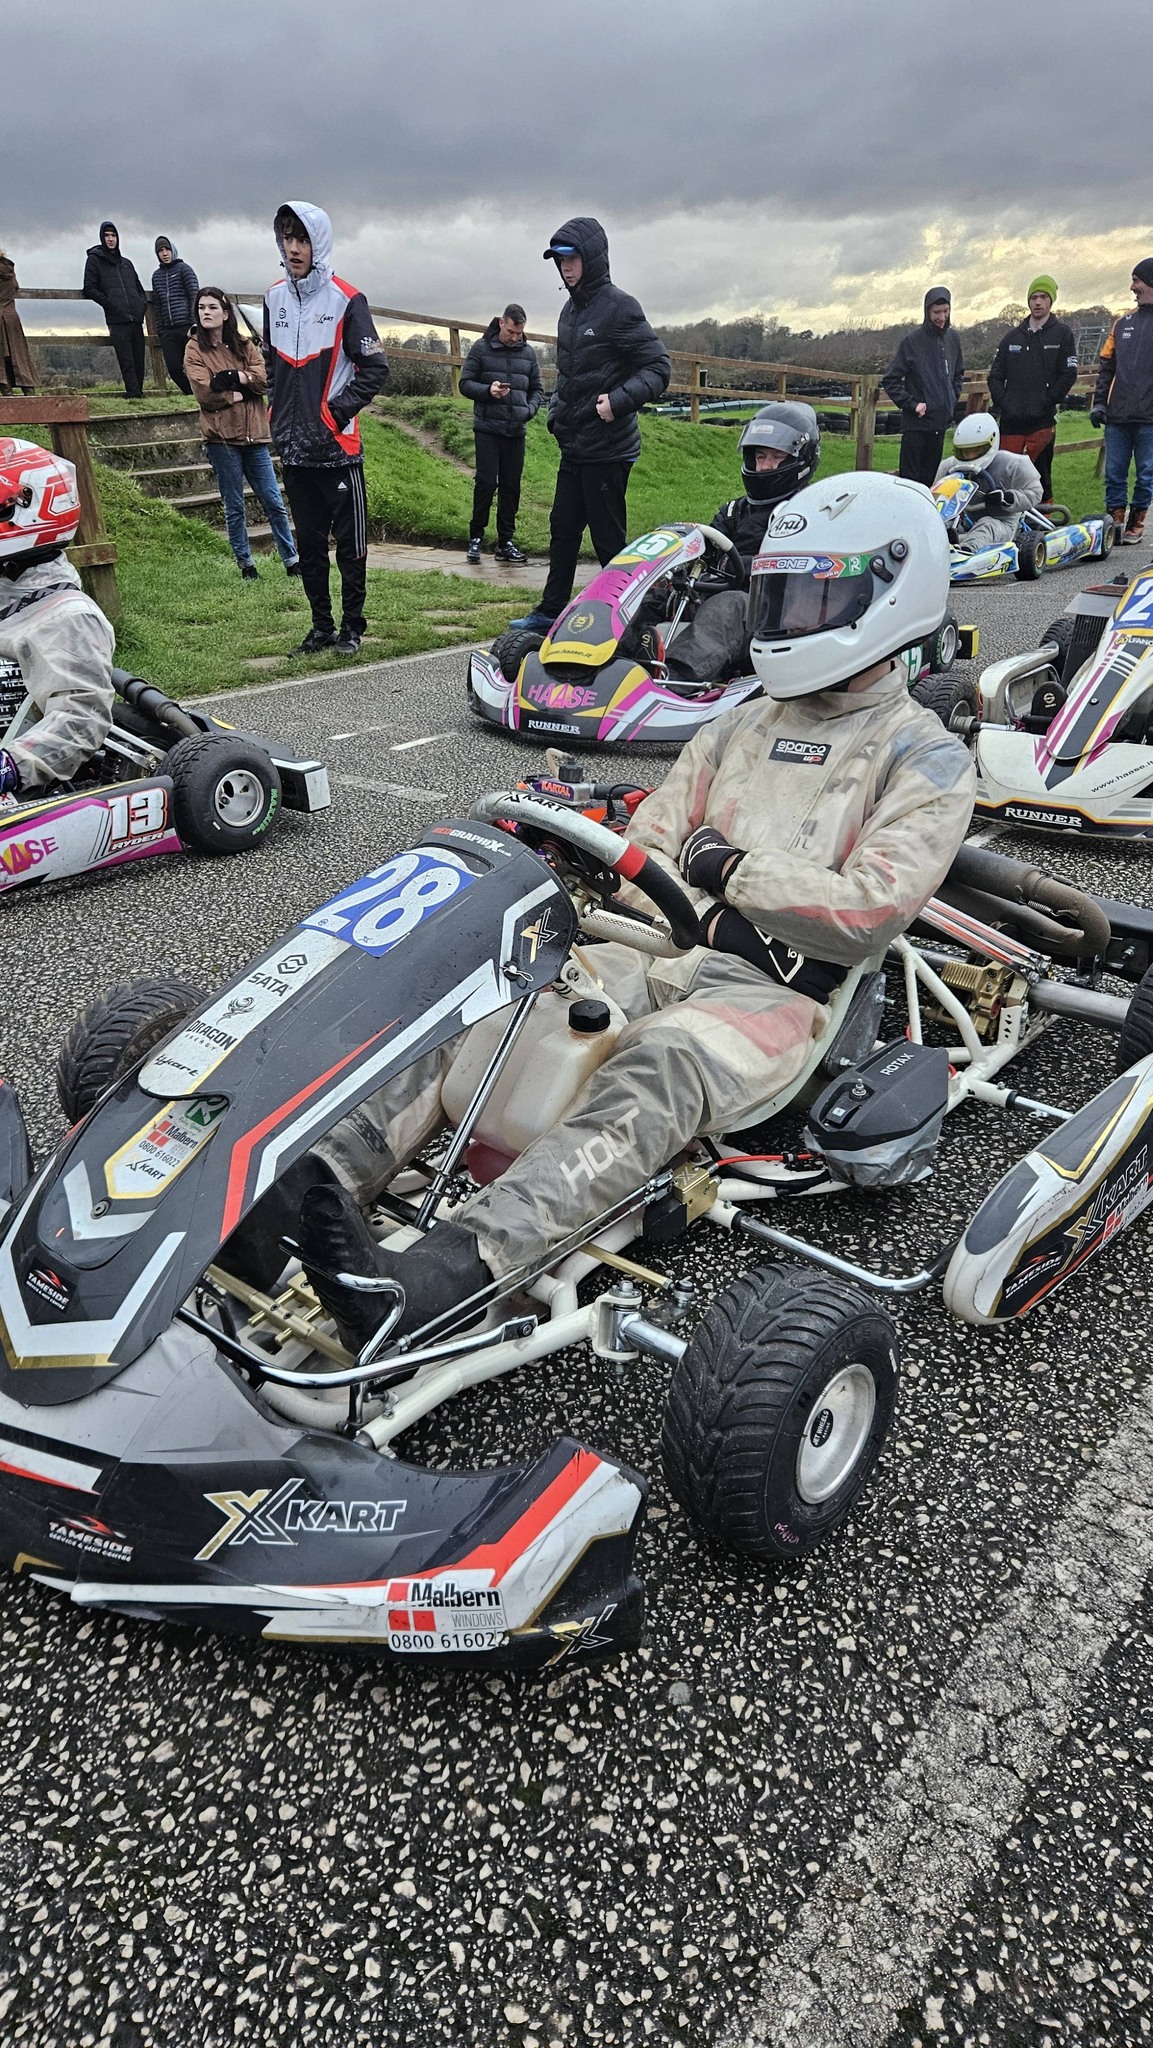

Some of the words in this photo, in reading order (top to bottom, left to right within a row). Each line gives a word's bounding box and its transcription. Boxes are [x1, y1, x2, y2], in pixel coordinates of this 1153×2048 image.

[772, 515, 804, 531] Arai
[528, 683, 597, 708] HAASE
[528, 719, 580, 735] RUNNER
[777, 740, 826, 756] sparco
[541, 780, 571, 797] KARTAL
[108, 788, 168, 841] 13
[1004, 807, 1082, 828] RUNNER
[111, 832, 164, 850] RYDER
[300, 854, 461, 947] 28
[248, 972, 290, 997] SATA
[186, 1020, 238, 1051] DRAGON
[880, 1053, 915, 1075] ROTAX
[166, 1125, 198, 1149] Malbern
[139, 1140, 156, 1154] 0800
[155, 1151, 181, 1168] 616022
[559, 1106, 640, 1196] HOLT
[1005, 1255, 1062, 1294] TAMESIDE
[28, 1272, 69, 1305] TAMESIDE
[816, 1410, 829, 1434] WHEELS
[49, 1521, 134, 1556] TAMESIDE
[412, 1583, 500, 1607] Malbern
[452, 1612, 504, 1628] WINDOWS
[392, 1634, 434, 1649] 0800
[441, 1630, 508, 1649] 616022
